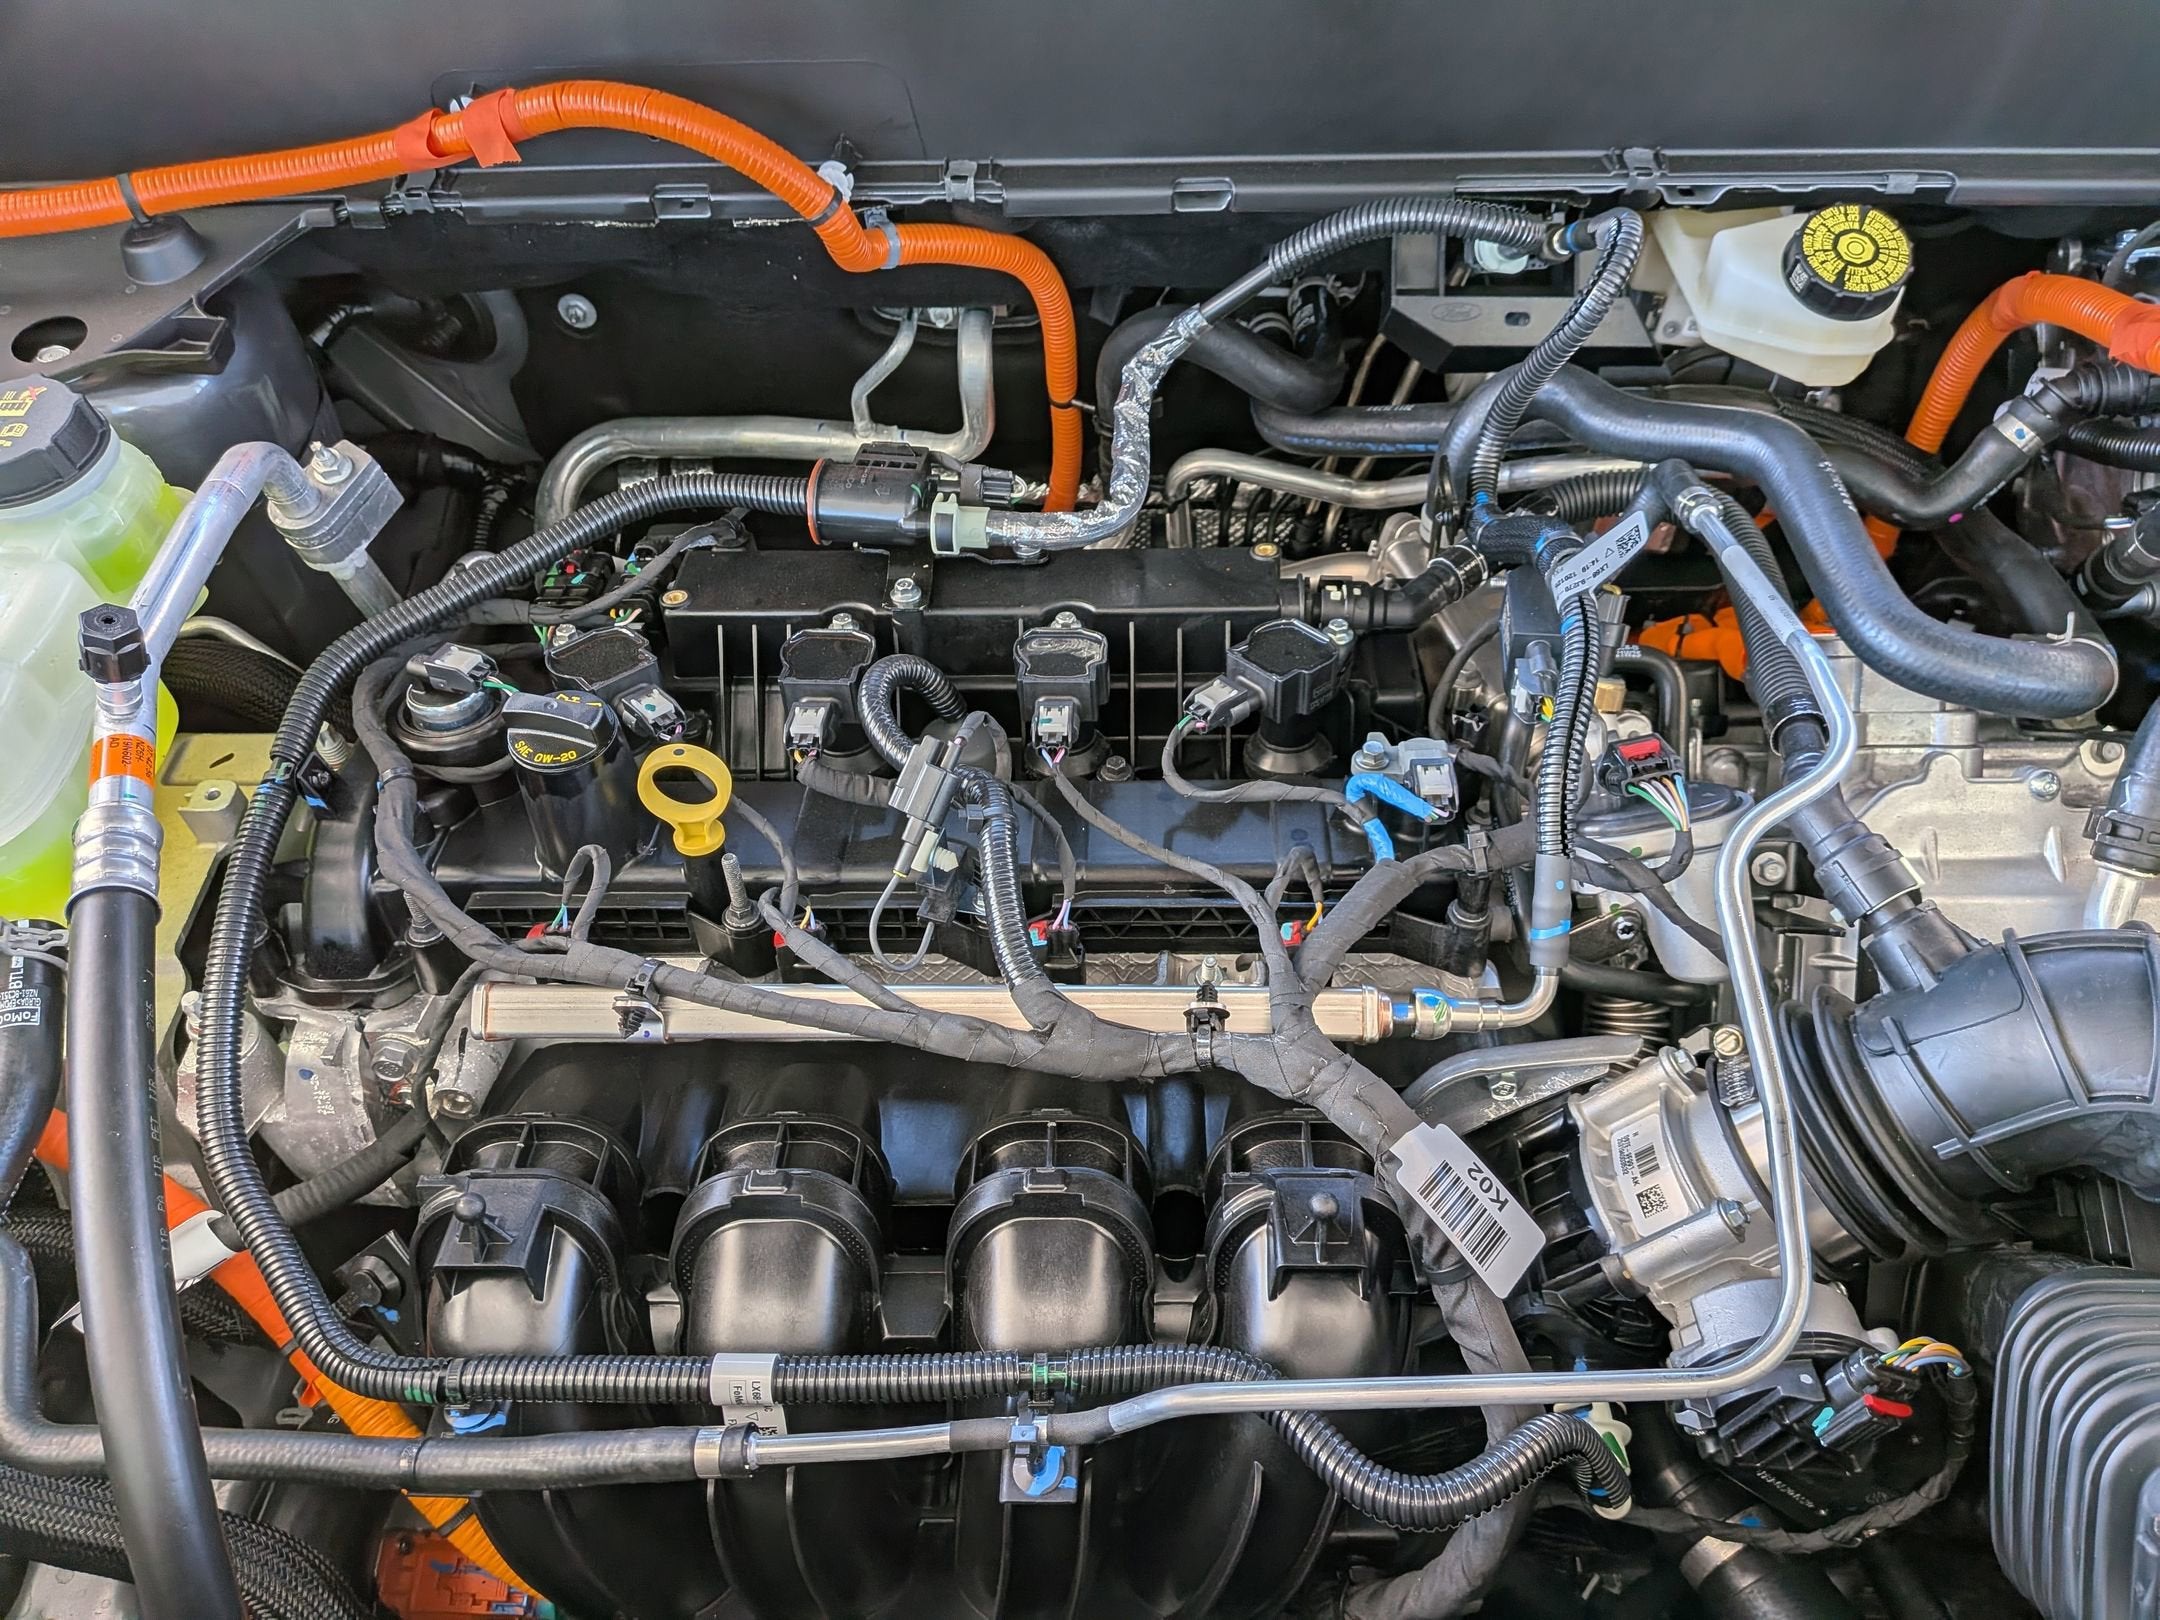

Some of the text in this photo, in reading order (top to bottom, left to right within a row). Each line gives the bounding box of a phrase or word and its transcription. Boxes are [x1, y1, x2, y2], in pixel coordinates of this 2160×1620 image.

[514, 740, 577, 764] SAE 0W-20
[1467, 1161, 1509, 1213] K02
